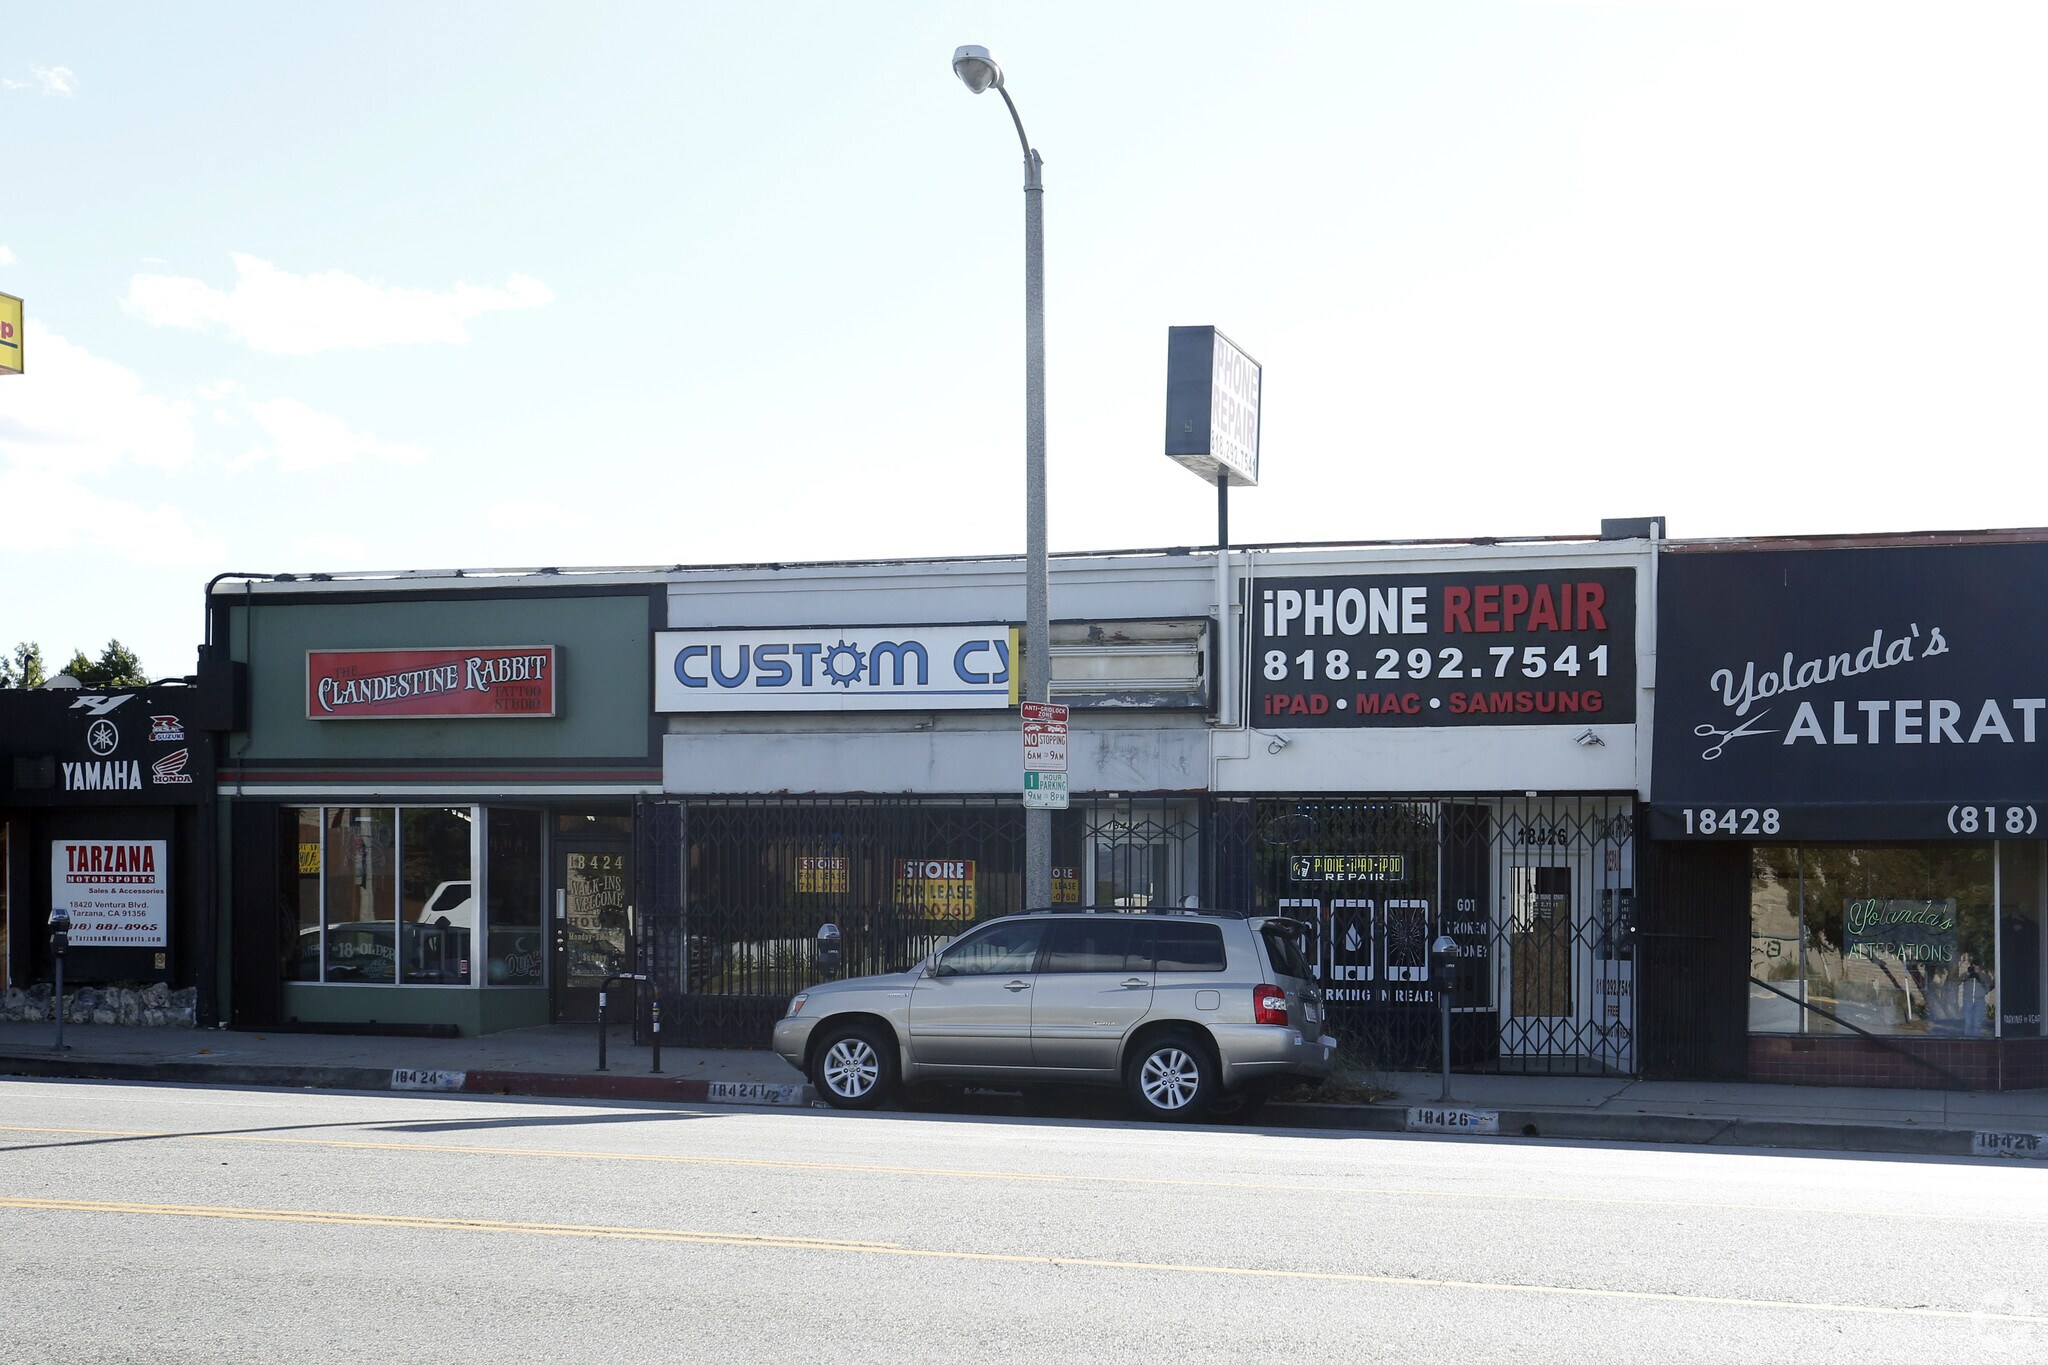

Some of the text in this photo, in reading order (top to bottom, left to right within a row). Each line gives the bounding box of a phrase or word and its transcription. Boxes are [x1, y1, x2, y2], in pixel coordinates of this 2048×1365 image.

[1212, 384, 1256, 452] REPAIR
[1263, 582, 1608, 637] iPHONE REPAIR
[1263, 645, 1609, 681] 818.292.7541
[1710, 623, 1949, 717] Yolanda's
[336, 666, 357, 678] THE
[494, 685, 541, 697] TATTOO
[494, 698, 541, 710] STUDIO
[1024, 705, 1066, 715] ANTI-GRIDLOCK
[1263, 691, 1603, 715] iPAD MAC SAMSUNG
[1038, 711, 1053, 719] ZONE
[1783, 699, 2046, 745] ALTERAT
[1024, 733, 1066, 746] NO STOPPING
[1027, 750, 1042, 760] 6AM
[1049, 750, 1064, 761] 9AM
[62, 760, 143, 791] YAMAHA
[154, 775, 192, 784] HONDA
[1040, 780, 1067, 791] PARKING
[1683, 805, 2038, 835] 18428 (818)
[1518, 828, 1566, 845] 18426
[66, 845, 155, 872] TARZANA
[569, 855, 623, 870] 18424
[803, 859, 843, 869] STORE
[904, 861, 964, 879] STORE
[1325, 873, 1385, 881] REPAIR
[930, 884, 973, 899] LEASE
[128, 901, 149, 909] Blvd.
[1456, 898, 1476, 912] GOT
[1847, 898, 1953, 935] Yolanda's
[95, 923, 158, 931] 881-8965
[338, 942, 354, 958] 18
[1455, 944, 1488, 958] HONE?
[1847, 942, 1954, 962] ALTERATIONS
[1321, 989, 1371, 1001] RKING
[1395, 989, 1434, 1002] REAR
[395, 1070, 437, 1084] 18424
[1418, 1109, 1468, 1126] 18426
